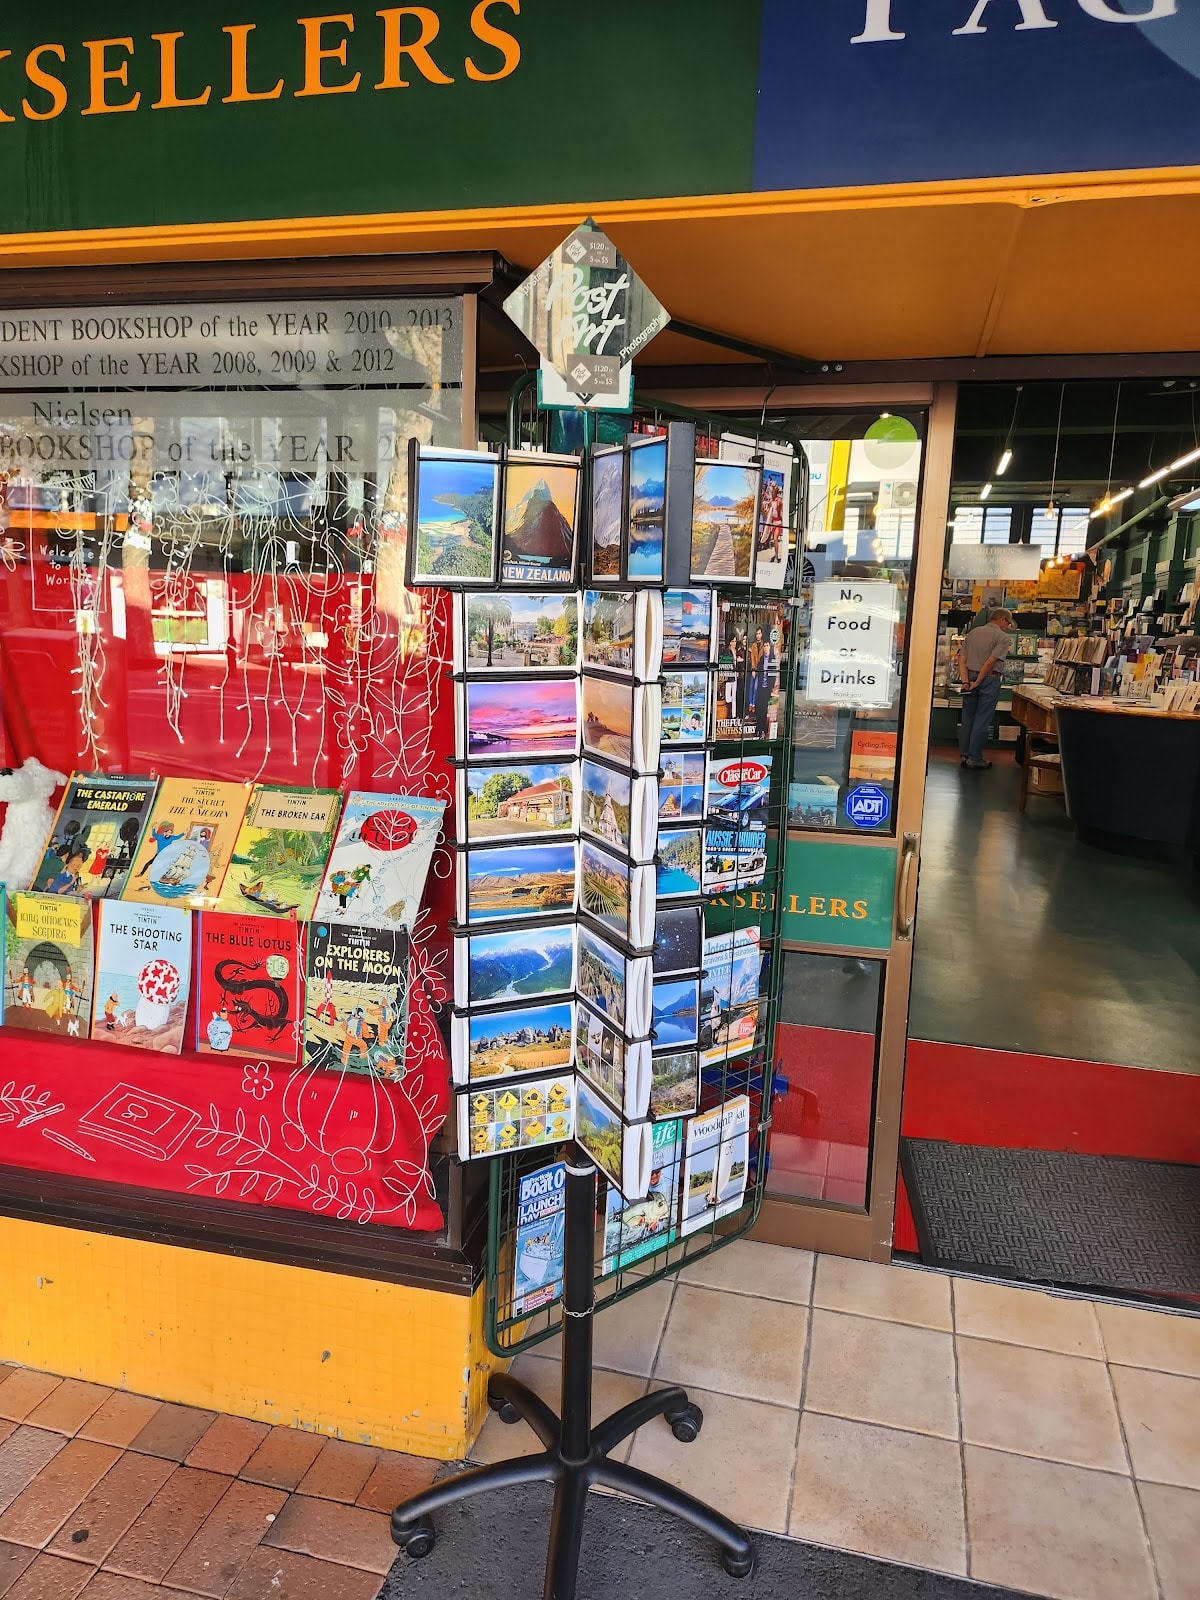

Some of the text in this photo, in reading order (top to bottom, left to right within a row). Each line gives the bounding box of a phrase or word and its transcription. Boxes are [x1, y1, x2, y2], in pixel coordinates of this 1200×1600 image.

[546, 268, 630, 320] Post
[71, 316, 193, 341] BOOKSHOP
[199, 315, 220, 338] of
[228, 313, 258, 337] the
[266, 311, 331, 336] YEAR
[405, 307, 453, 332] 2013
[72, 353, 93, 376] of
[99, 354, 130, 376] the
[137, 352, 202, 375] YEAR
[213, 350, 261, 376] 2008,
[271, 349, 316, 373] 2009
[327, 349, 343, 372] &
[352, 348, 395, 372] 2012
[30, 401, 132, 427] Nielsen
[168, 435, 197, 462] of
[209, 437, 251, 462] the
[263, 434, 358, 462] YEAR
[50, 560, 62, 571] to
[502, 566, 571, 582] NEW ZEALAND
[840, 589, 863, 605] No
[827, 616, 871, 631] Food
[820, 669, 876, 686] Drinks
[857, 741, 879, 750] Cycling
[721, 768, 763, 784] Classic Car
[76, 789, 147, 802] THE CASTAFIORE
[197, 798, 227, 807] SECRET
[86, 800, 129, 812] EMERALD
[853, 798, 882, 815] ADT
[261, 808, 326, 821] THE BROKEN EAR
[705, 830, 735, 848] AUSSIE
[39, 904, 58, 912] TINTIN
[138, 916, 157, 925] TINTIN
[110, 923, 182, 942] THE SHOOTING
[239, 926, 260, 934] TINTIN
[133, 938, 158, 952] STAR
[205, 932, 292, 952] THE BLUE LOTUS
[347, 937, 371, 947] TINTIN
[326, 943, 392, 963] EXPLORERS
[314, 955, 402, 977] ON THE MOON
[522, 1176, 554, 1202] Boat
[519, 1193, 561, 1217] LAUNCH
